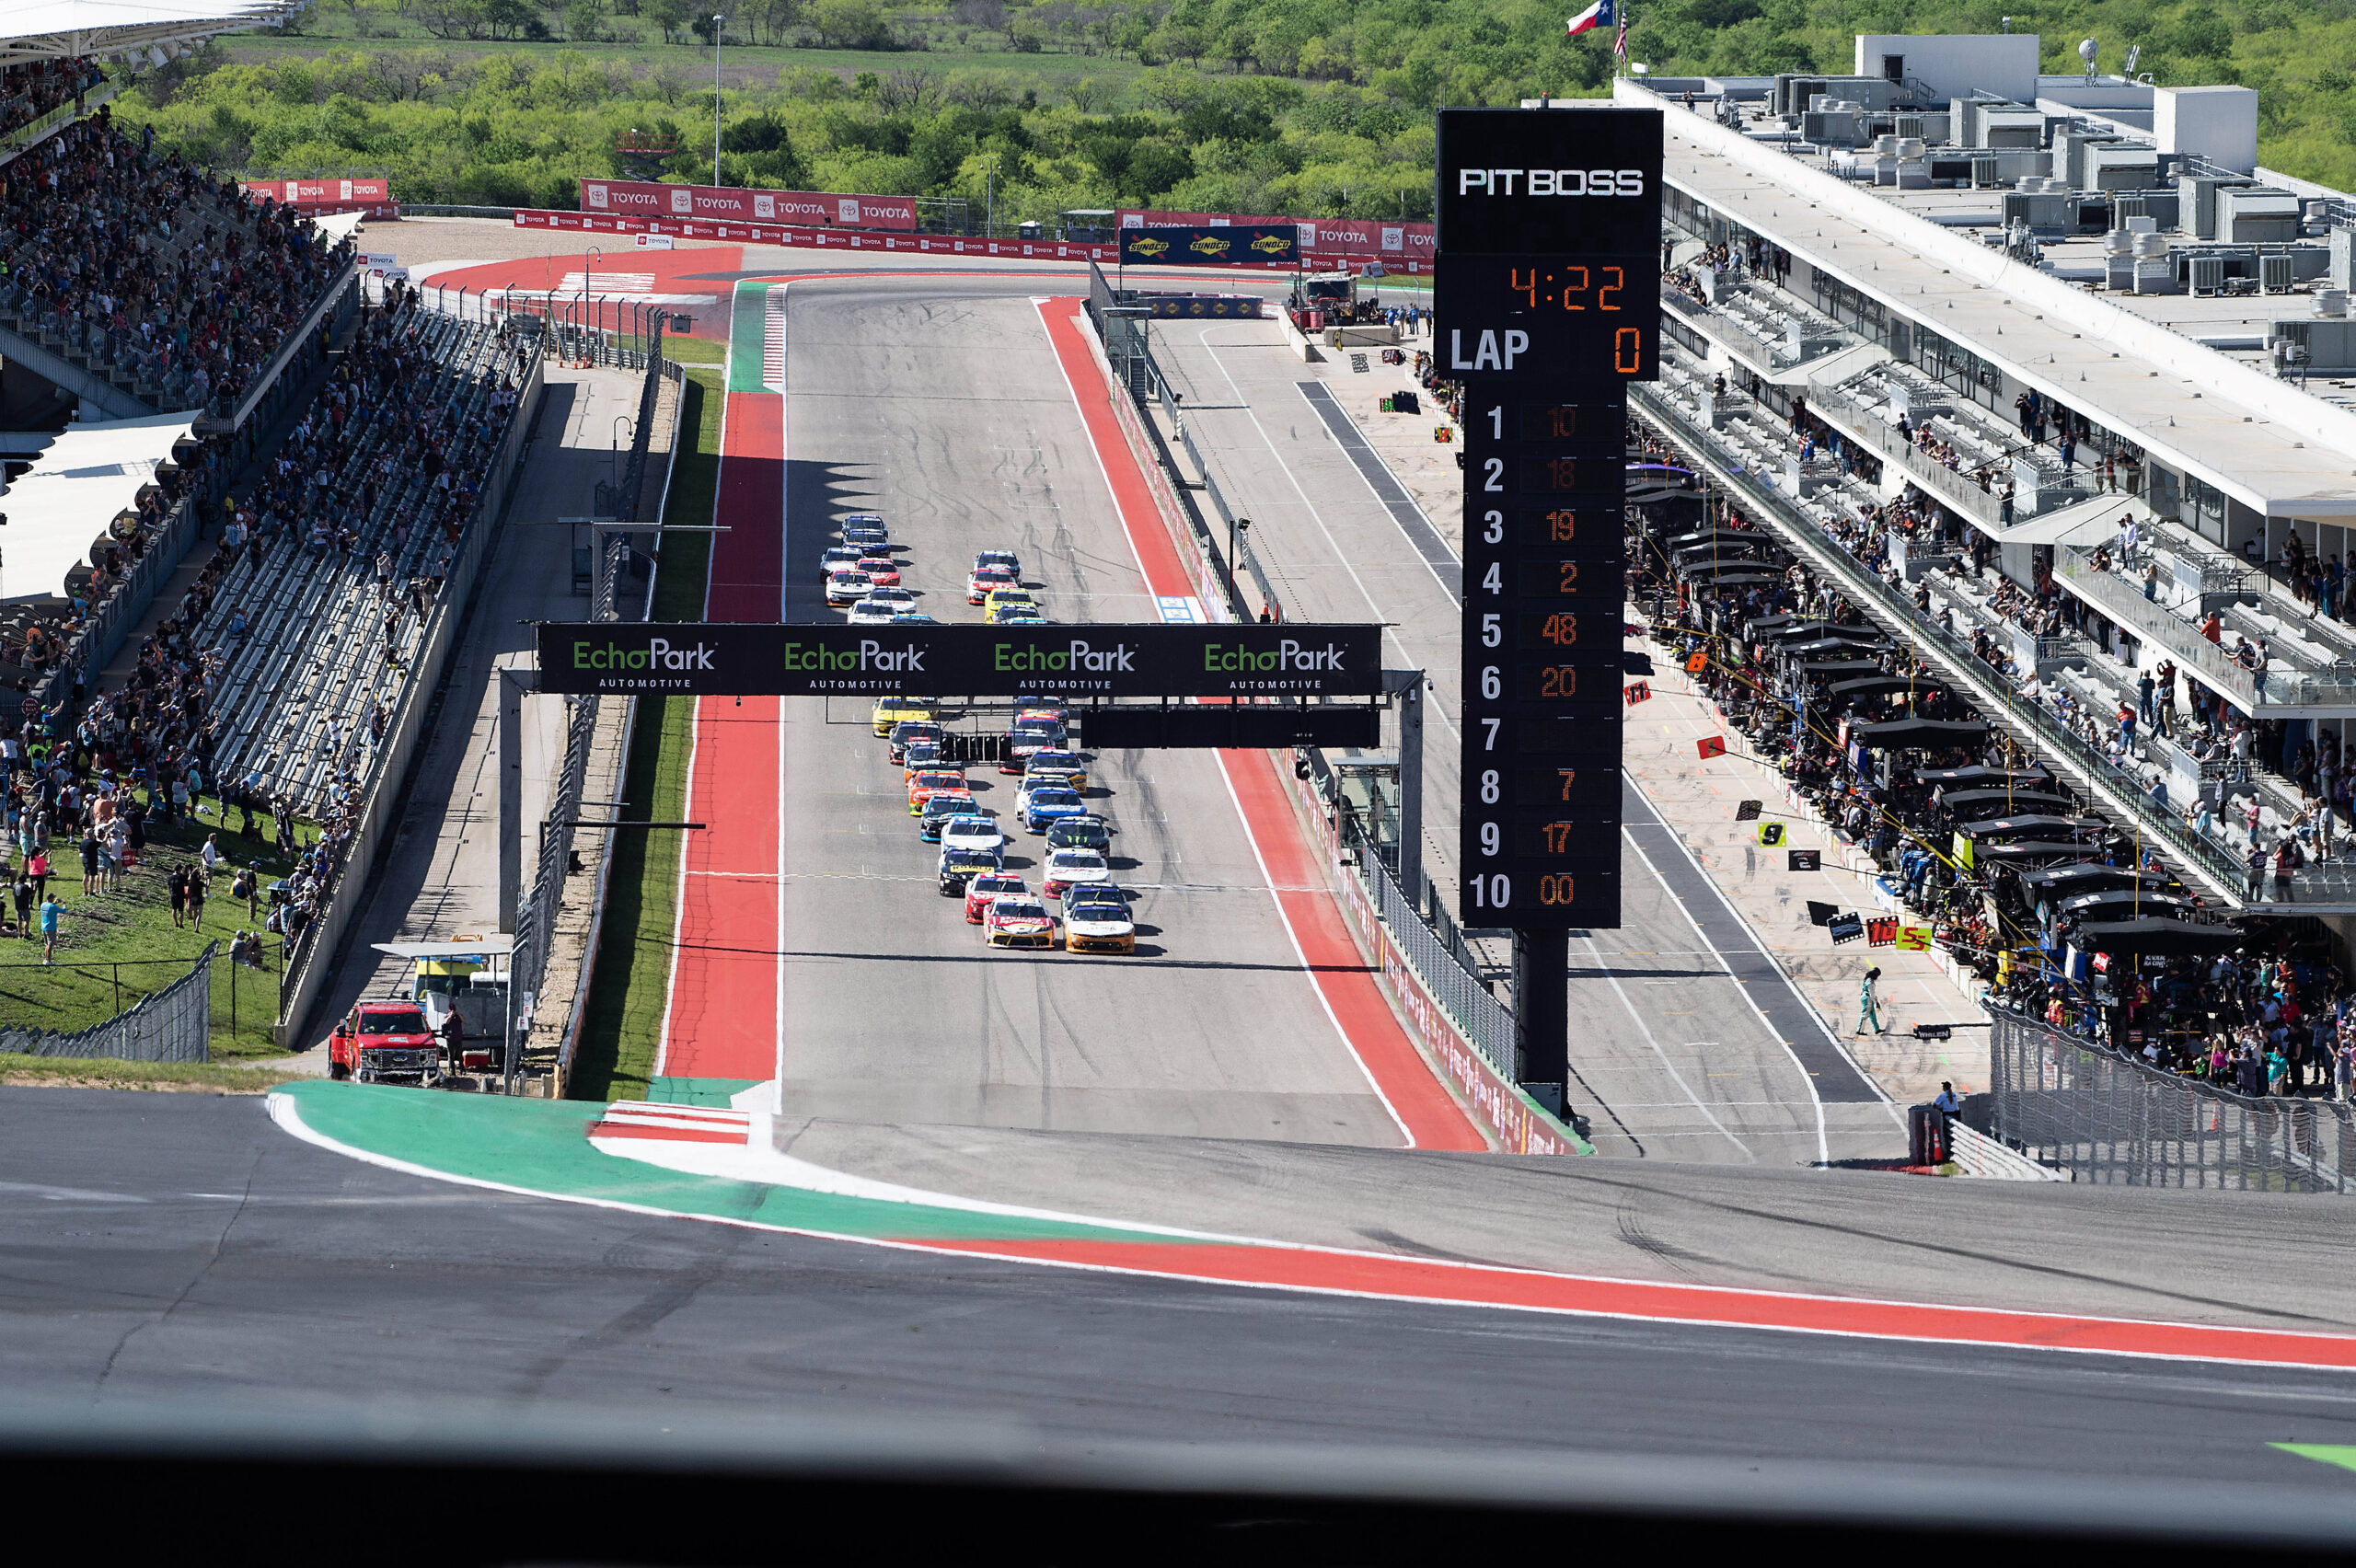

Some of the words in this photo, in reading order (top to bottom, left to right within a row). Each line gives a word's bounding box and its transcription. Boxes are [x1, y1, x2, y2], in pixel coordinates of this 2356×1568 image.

[299, 187, 324, 195] TOYOTA
[353, 186, 377, 194] TOYOTA
[1460, 169, 1523, 195] PIT
[1529, 169, 1644, 196] BOSS
[611, 193, 658, 204] TOYOTA
[696, 197, 742, 210] TOYOTA
[779, 202, 825, 214] TOYOTA
[862, 207, 910, 219] TOYOTA
[1129, 243, 1169, 251] SUNOCO
[1191, 242, 1230, 250] SUNOCO
[1320, 230, 1368, 243] TOYOTA
[1512, 266, 1623, 310] 4:22
[1451, 329, 1530, 370] LAP
[1615, 328, 1640, 373] 0
[1487, 405, 1502, 440] 1
[1548, 407, 1576, 438] 10
[1484, 458, 1504, 491] 2
[1548, 460, 1575, 490] 18
[1484, 510, 1503, 544] 3
[1546, 511, 1574, 541] 19
[1482, 561, 1502, 594] 4
[1560, 563, 1577, 593] 2
[1482, 613, 1502, 648] 5
[1542, 615, 1576, 644] 48
[574, 639, 716, 670] EchoPark
[785, 640, 927, 672] EchoPark
[995, 640, 1138, 672] EchoPark
[1205, 640, 1346, 672] EchoPark
[1685, 652, 1708, 673] 8
[599, 678, 691, 688] AUTOMOTIVE
[810, 679, 902, 690] AUTOMOTIVE
[1020, 679, 1112, 690] AUTOMOTIVE
[1230, 679, 1322, 690] AUTOMOTIVE
[1482, 665, 1501, 699] 6
[1542, 667, 1576, 698] 20
[1629, 684, 1646, 704] 11
[1481, 718, 1501, 751] 7
[1481, 769, 1500, 804] 8
[1559, 771, 1576, 801] 7
[1480, 822, 1500, 856] 9
[1542, 823, 1572, 853] 17
[1761, 824, 1784, 845] 9
[1470, 874, 1511, 908] 10
[1541, 875, 1574, 905] 00
[1870, 921, 1898, 942] 10
[1918, 1030, 1949, 1038] WHELEN
